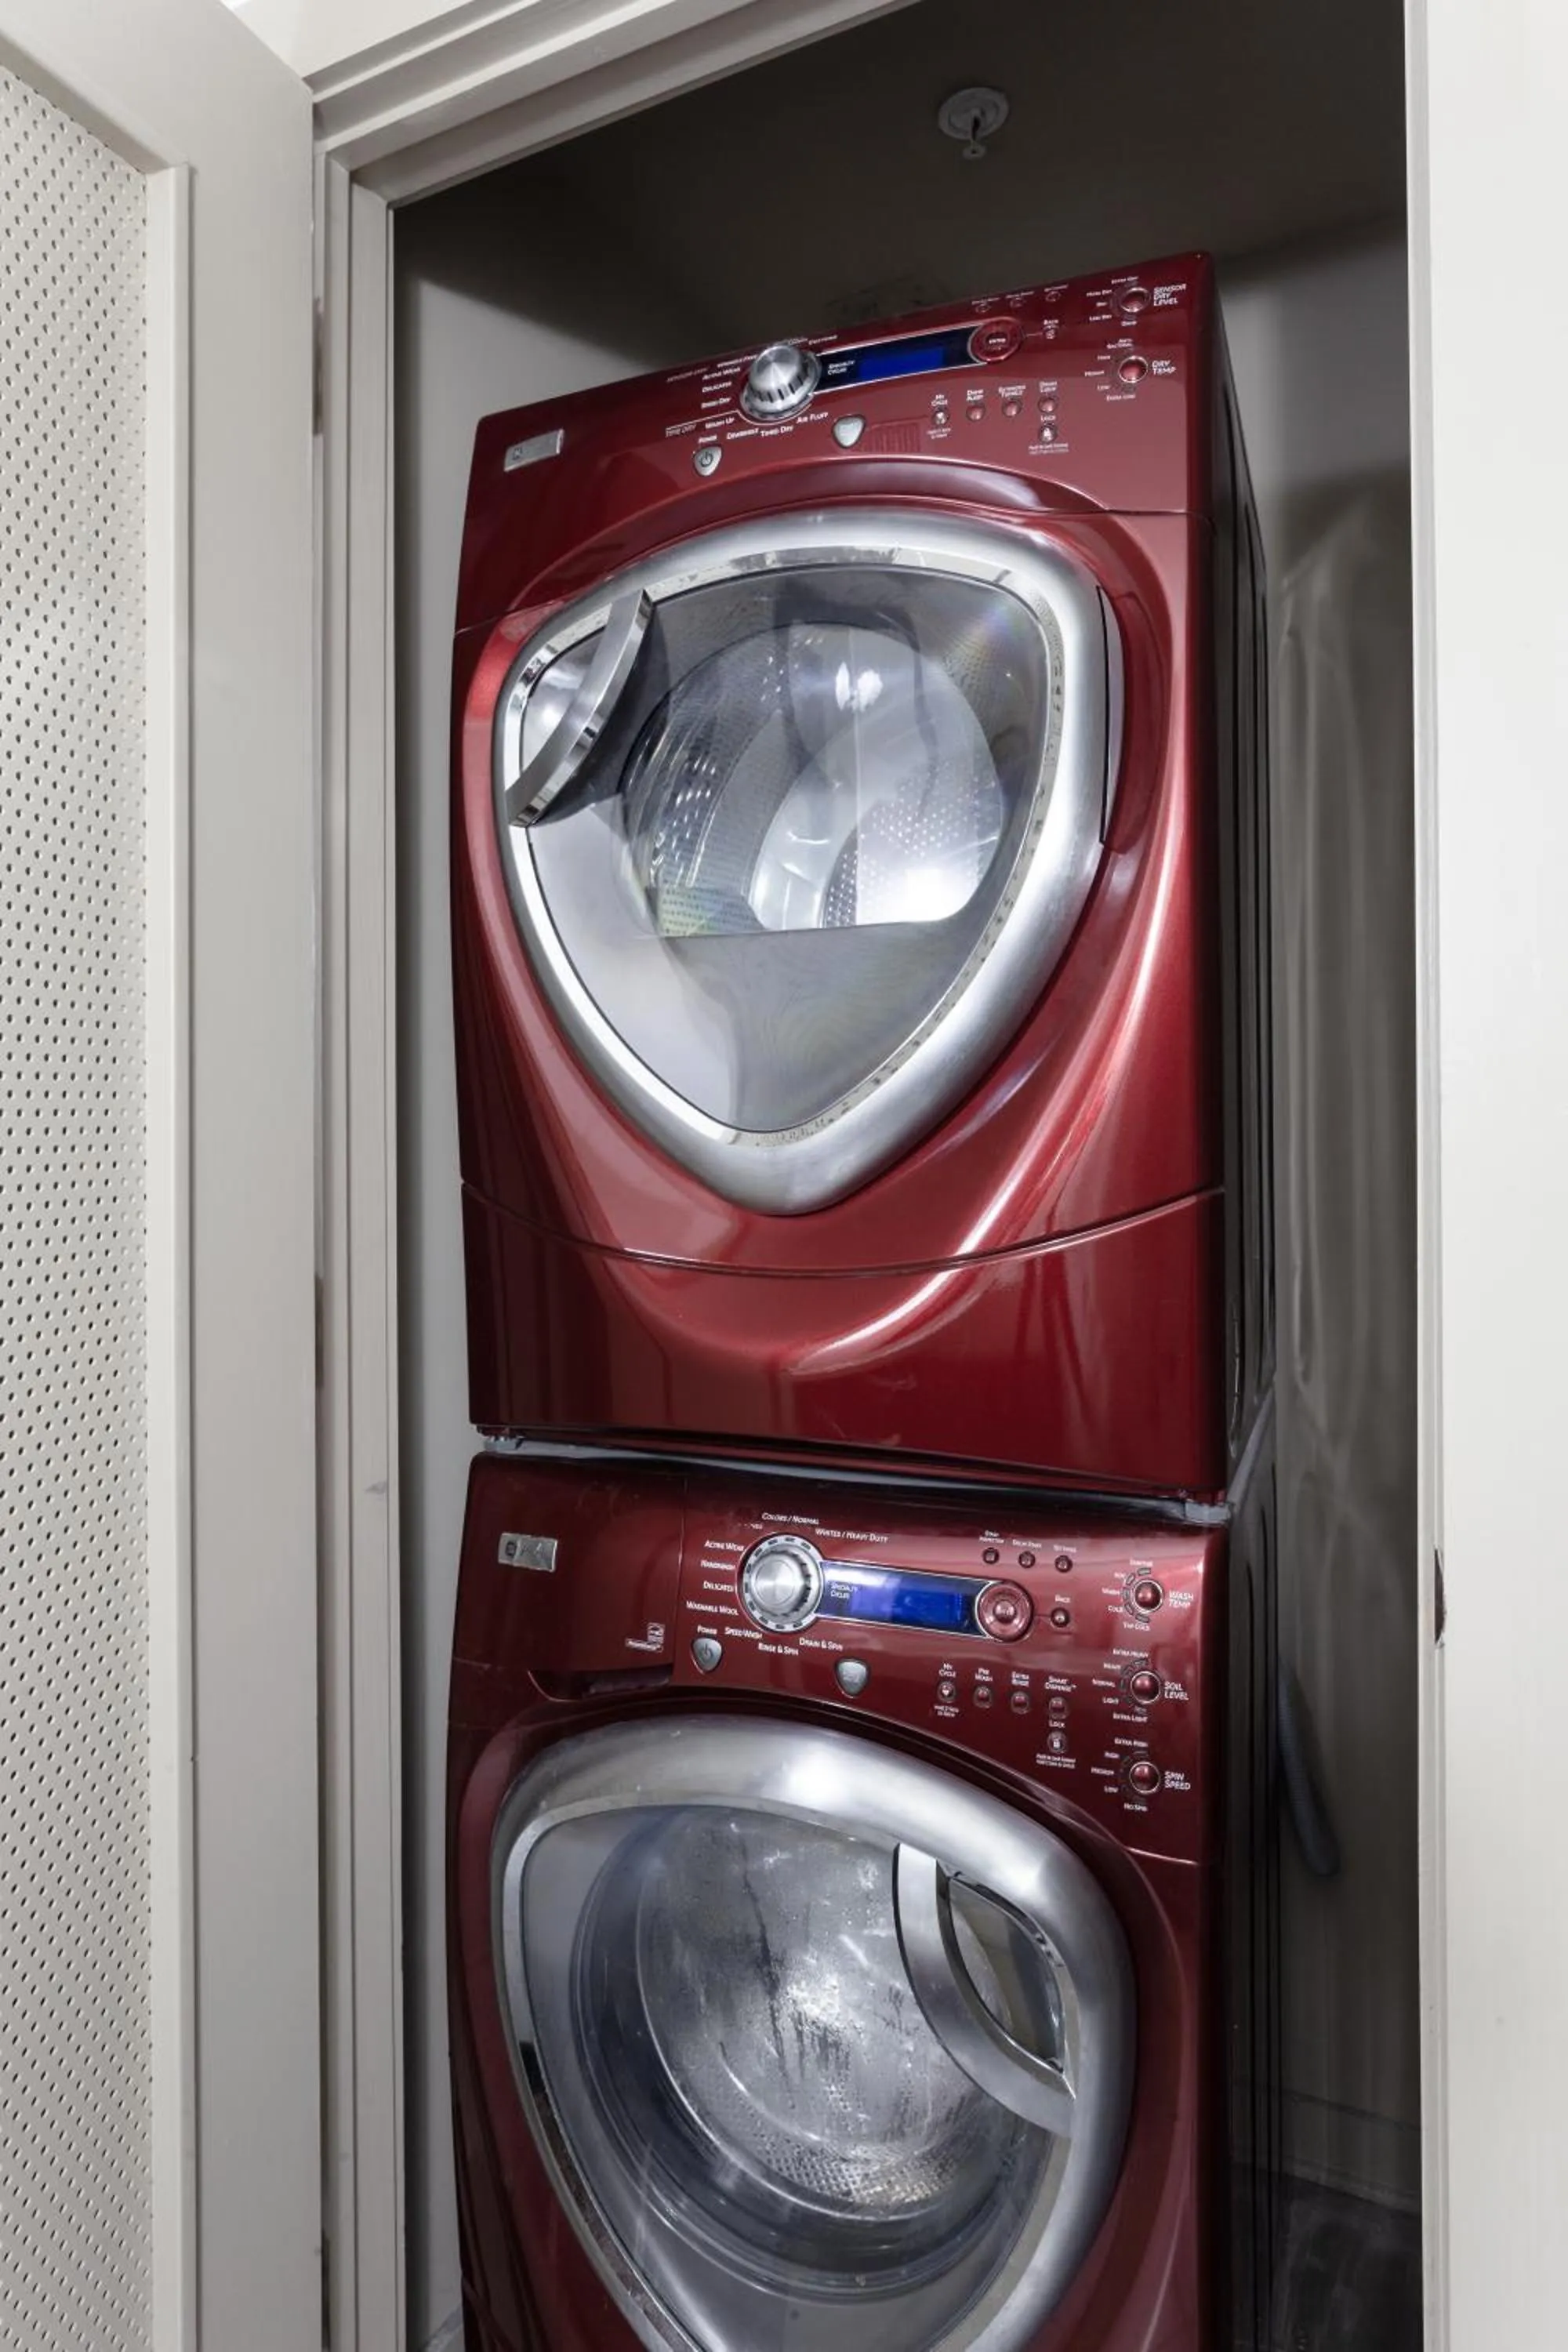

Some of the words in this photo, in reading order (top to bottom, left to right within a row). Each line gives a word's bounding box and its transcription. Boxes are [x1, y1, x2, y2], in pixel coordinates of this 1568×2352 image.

[1153, 284, 1186, 293] SENSOR
[1153, 292, 1172, 300] DRY
[1153, 298, 1178, 307] LEVEL
[1152, 366, 1176, 375] TEMP
[793, 1515, 820, 1525] NORMAL
[869, 1533, 890, 1543] DUTY
[726, 1542, 744, 1552] WEAR
[703, 1581, 735, 1592] DELICATES
[1169, 1591, 1193, 1601] WASH
[1169, 1599, 1191, 1608] TEMP
[719, 1606, 739, 1616] WOOL
[758, 1642, 775, 1653] RINSE
[784, 1646, 800, 1657] SPIN
[799, 1637, 820, 1648] DRAIN
[828, 1641, 844, 1652] SPIN
[1164, 1681, 1183, 1691] SOIL
[1164, 1690, 1189, 1701] LEVEL
[1164, 1770, 1184, 1781] SPIN
[1164, 1779, 1191, 1790] SPEED
